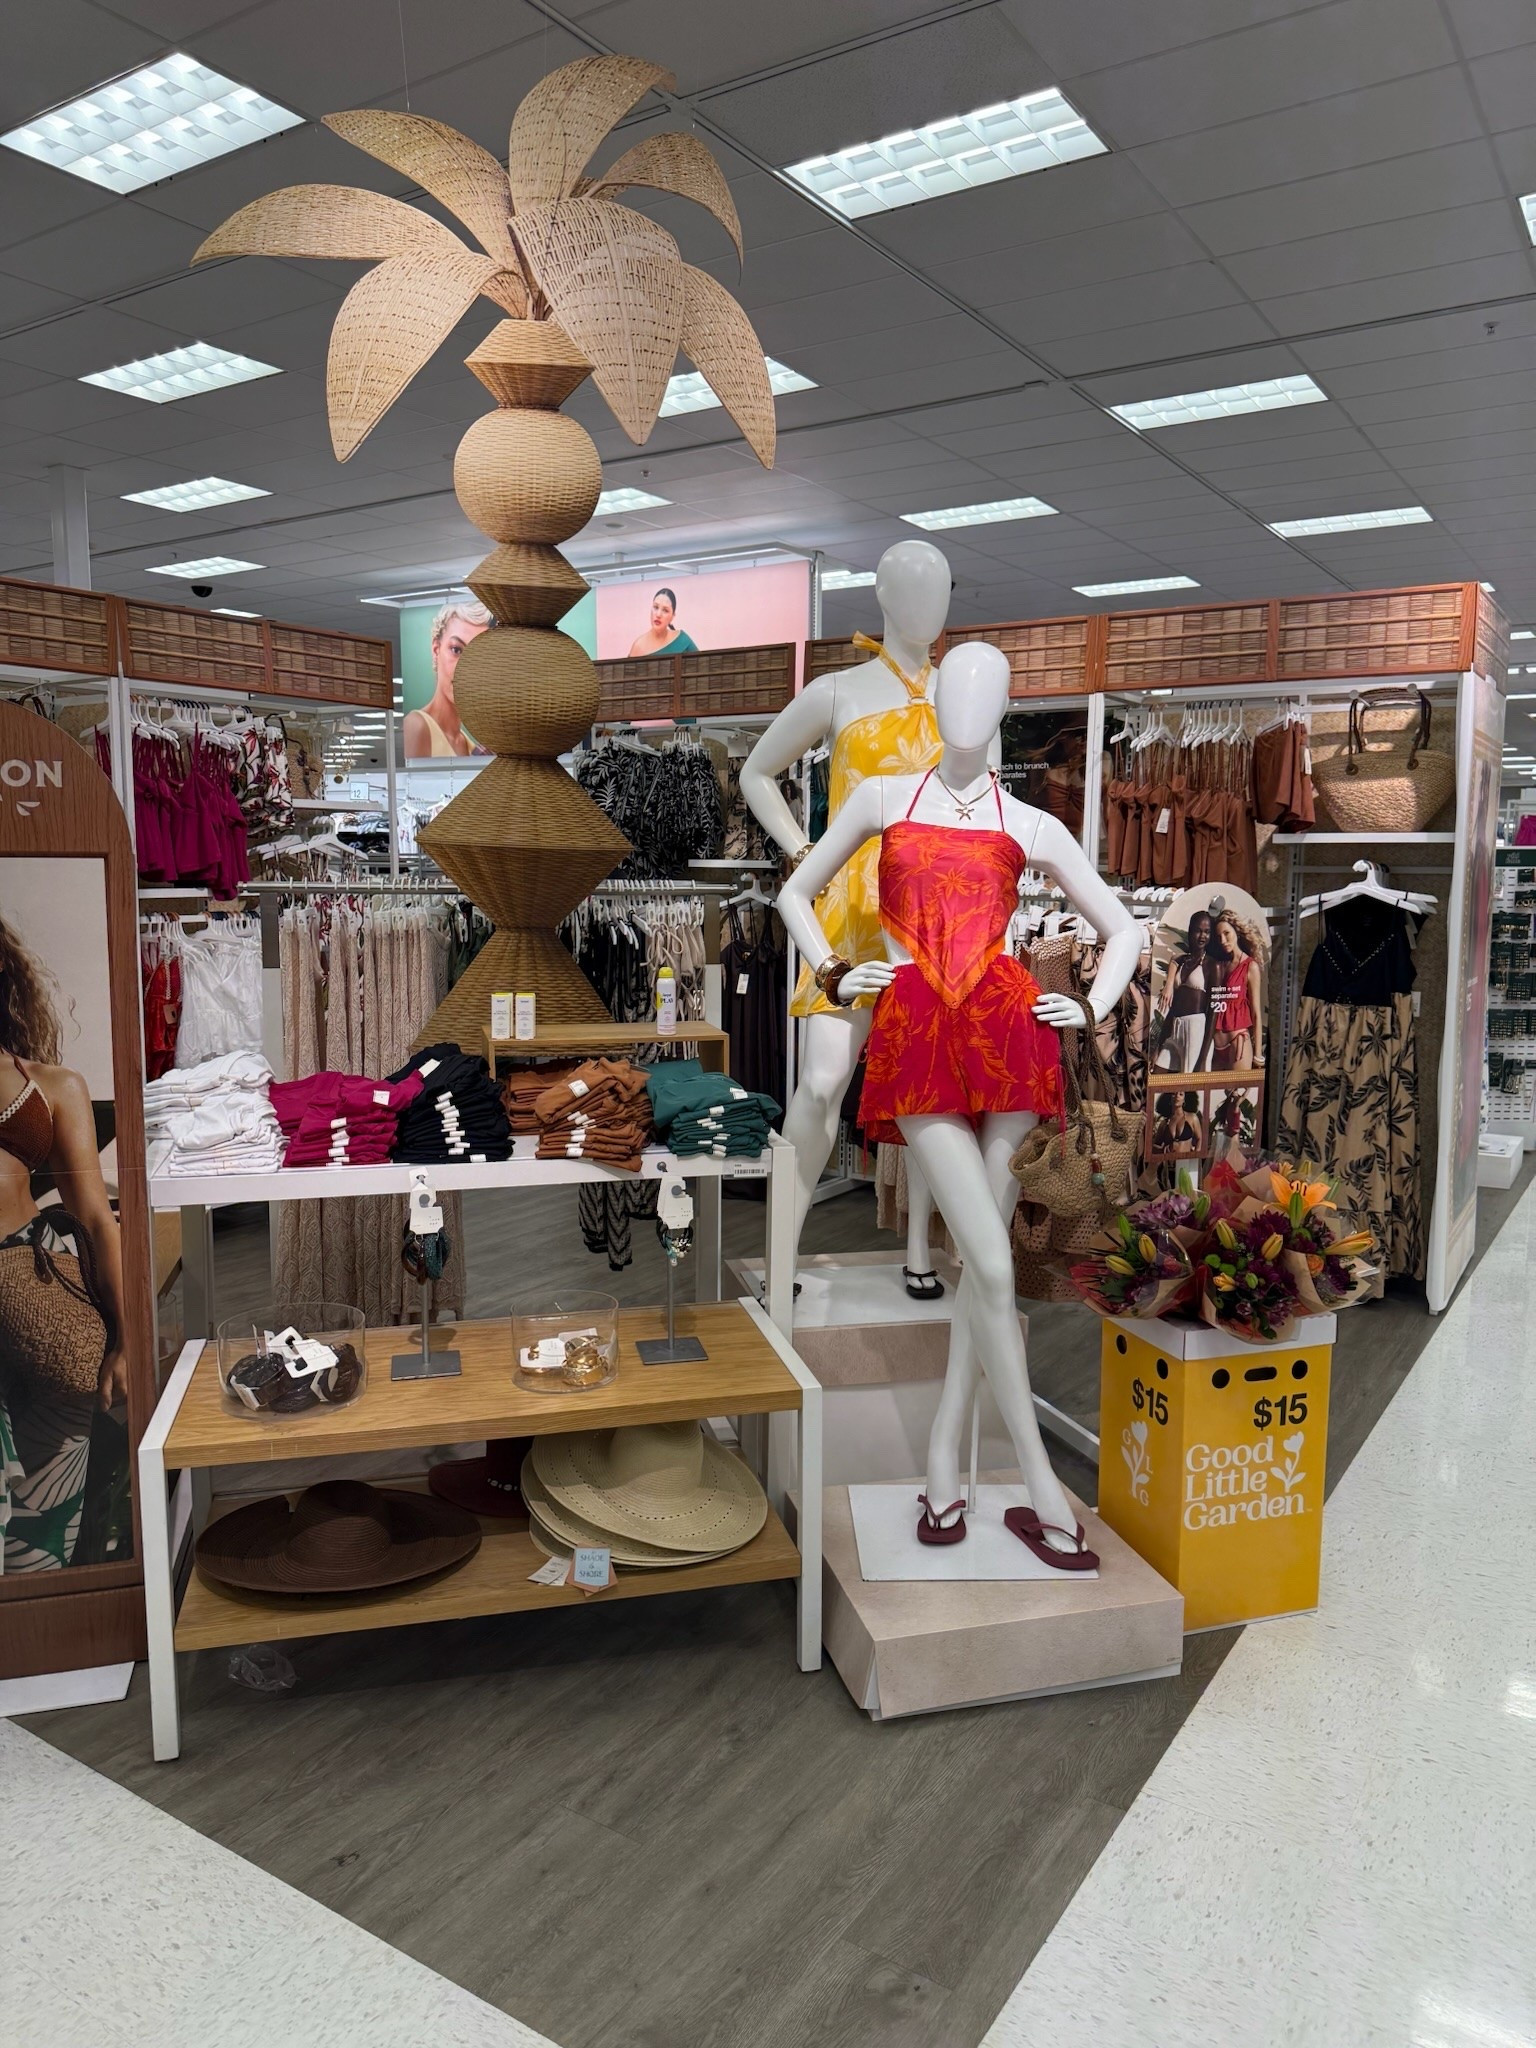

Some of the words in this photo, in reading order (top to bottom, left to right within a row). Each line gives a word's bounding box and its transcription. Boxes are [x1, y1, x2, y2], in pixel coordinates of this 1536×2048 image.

[1023, 762, 1049, 770] brunch
[1210, 1001, 1227, 1013] $20
[1132, 1377, 1168, 1425] $15
[1253, 1393, 1308, 1430] $15
[1186, 1435, 1273, 1473] Good
[1185, 1469, 1267, 1502] Little
[1184, 1493, 1305, 1531] Garden
[579, 1570, 604, 1578] SHORE
[580, 1554, 604, 1562] SHADE
